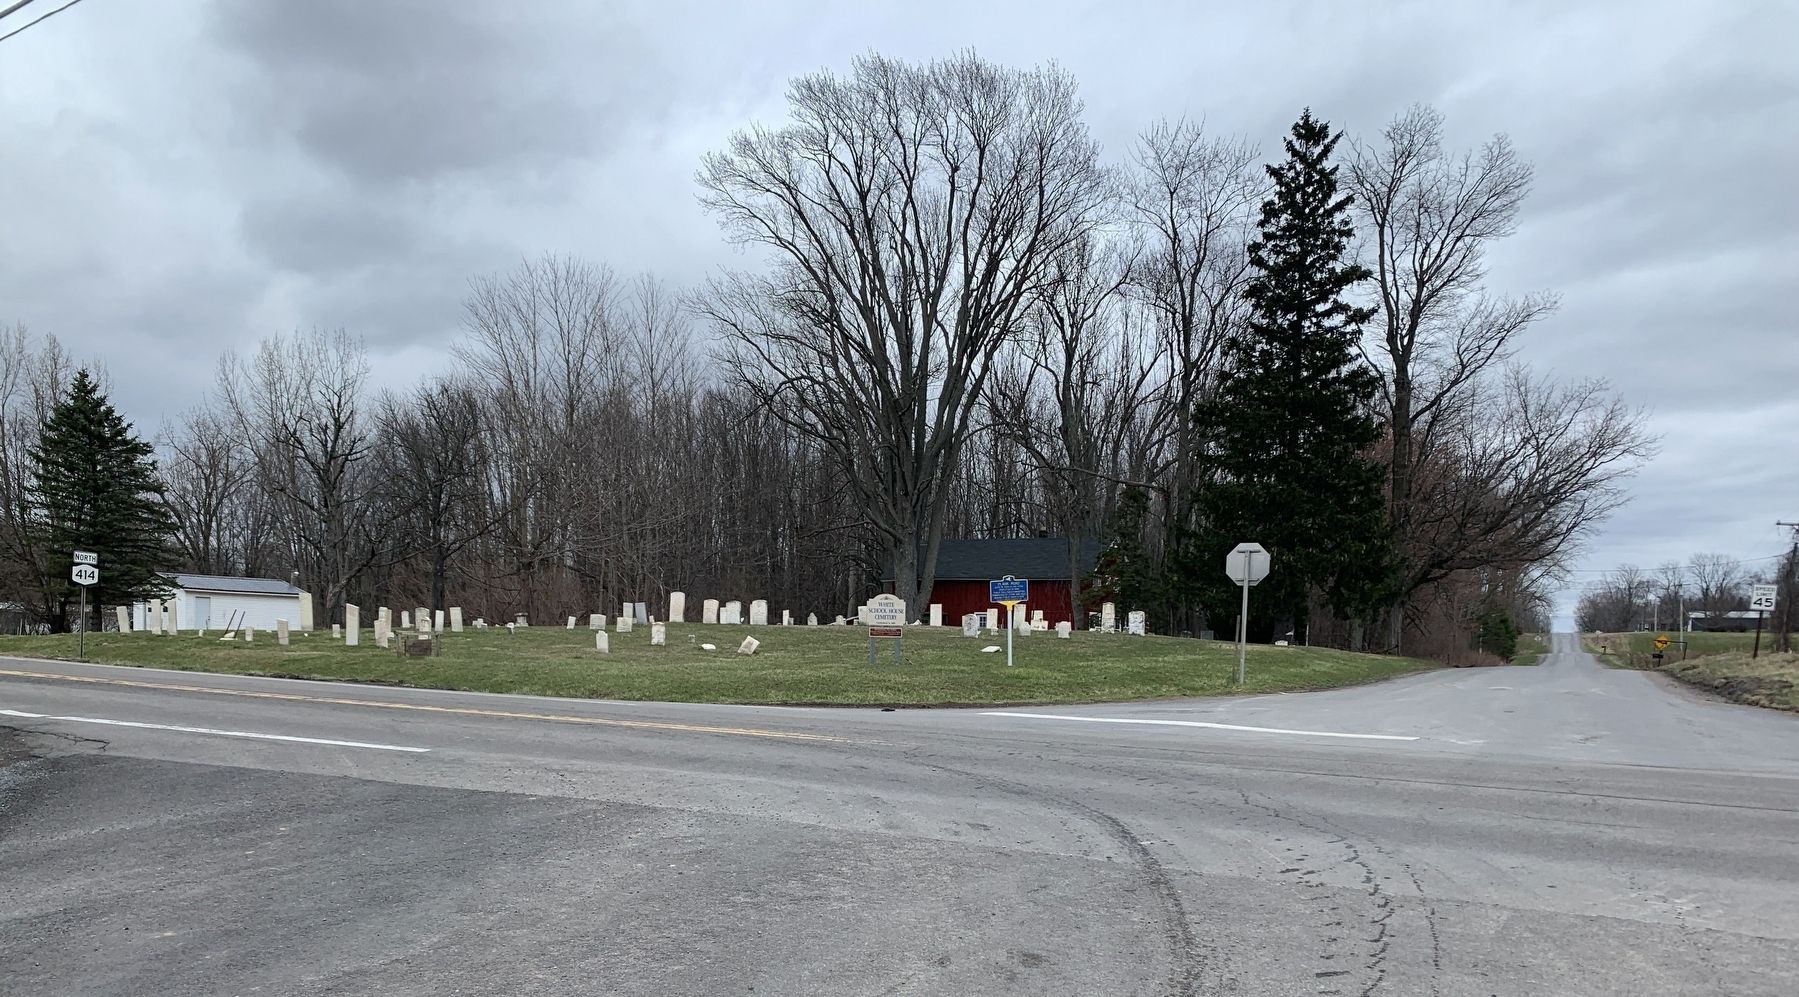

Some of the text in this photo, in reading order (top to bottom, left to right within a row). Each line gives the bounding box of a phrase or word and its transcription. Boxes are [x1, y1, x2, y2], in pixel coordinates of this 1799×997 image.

[75, 553, 97, 562] NORTH
[75, 569, 95, 580] 414
[1753, 597, 1774, 608] 45
